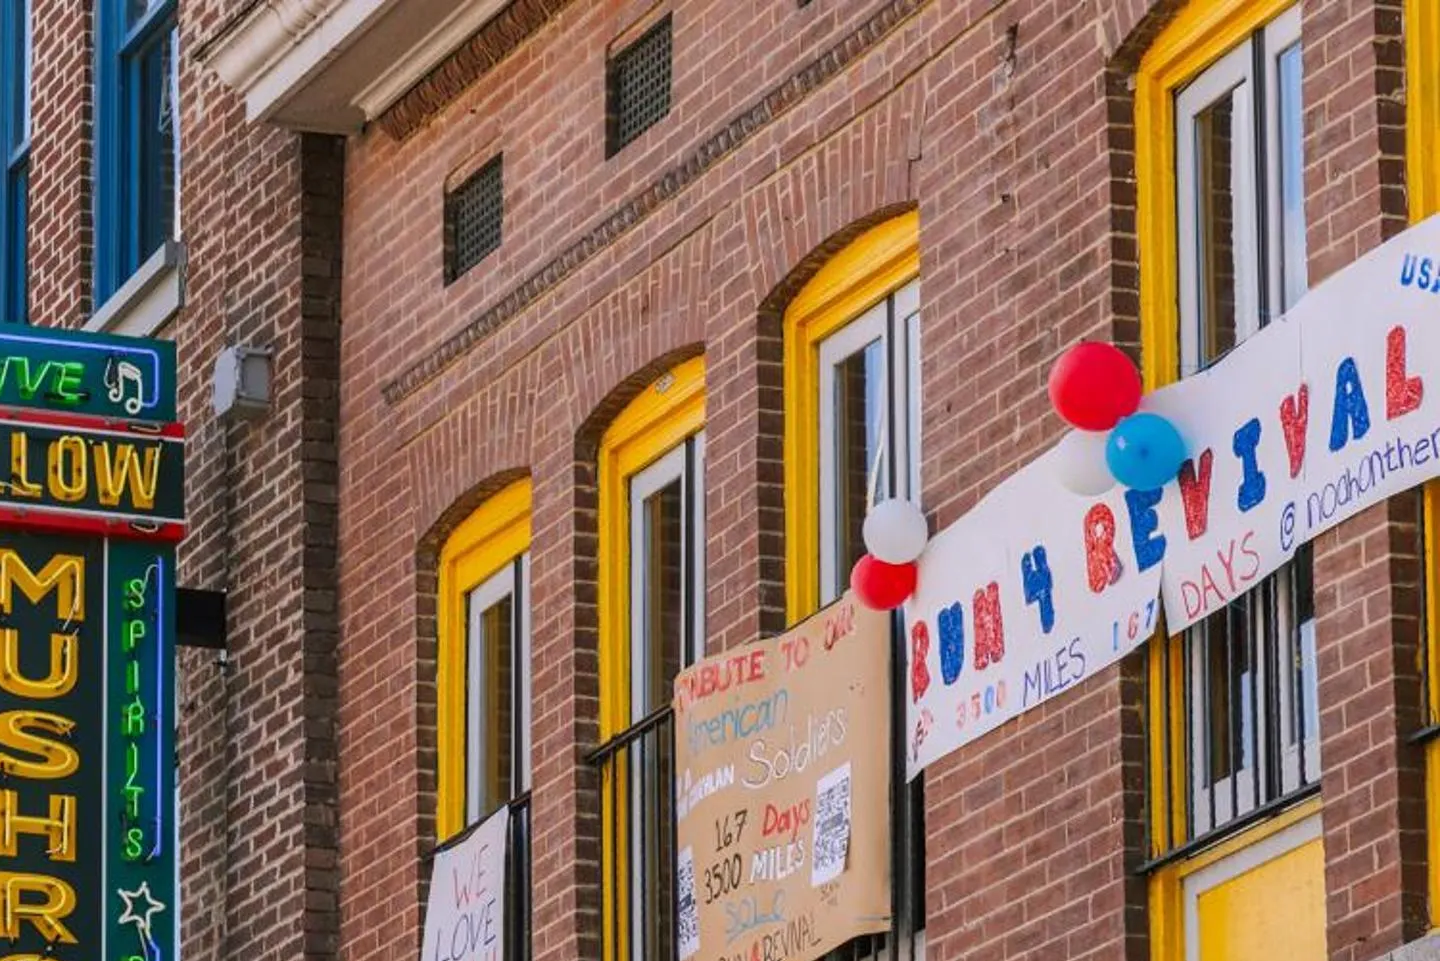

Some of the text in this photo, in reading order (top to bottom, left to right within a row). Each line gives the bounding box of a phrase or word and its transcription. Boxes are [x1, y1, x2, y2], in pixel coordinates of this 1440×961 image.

[911, 324, 1424, 704] RUN 4 REVIVAL
[1022, 637, 1086, 707] MILES
[1180, 531, 1261, 620] DAYS
[781, 634, 811, 673] TO
[121, 578, 146, 861] SPIRITS
[715, 799, 810, 852] 167 Days
[452, 843, 489, 910] WE
[705, 840, 806, 904] 3500 MILES
